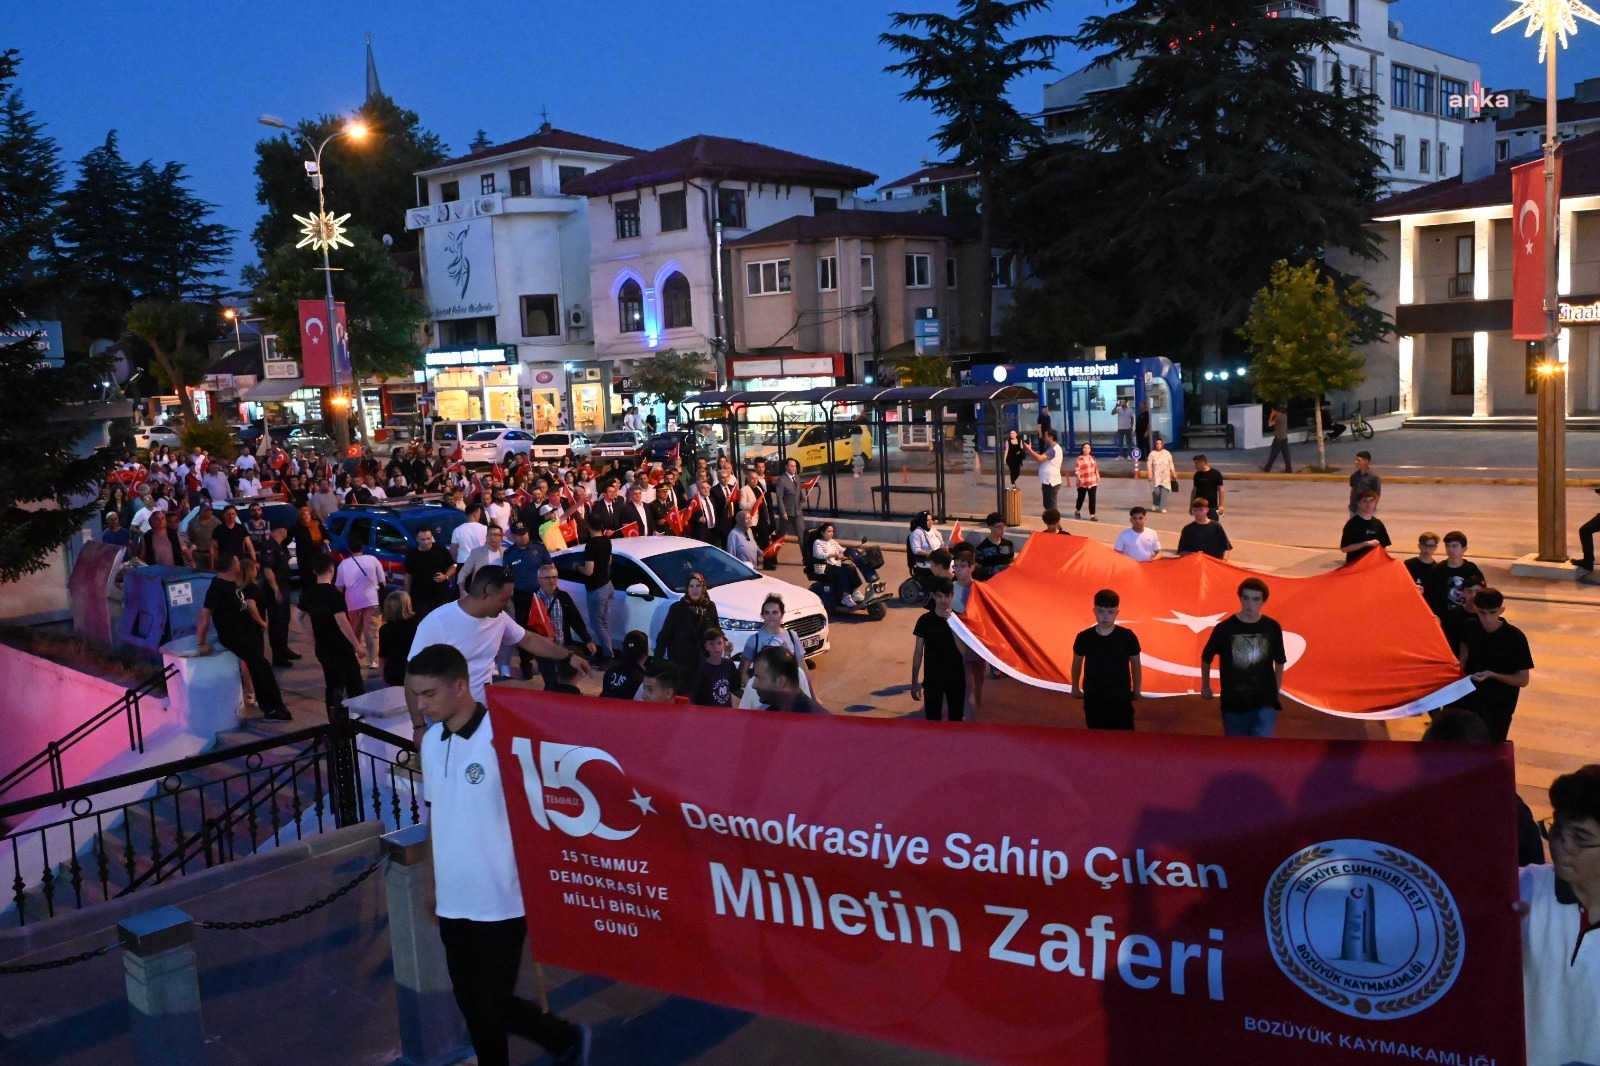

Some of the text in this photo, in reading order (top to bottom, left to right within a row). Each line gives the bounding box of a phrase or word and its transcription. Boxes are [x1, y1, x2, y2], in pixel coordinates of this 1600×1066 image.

[1027, 363, 1119, 378] BOZÜYÜK BELEDİYESİ
[561, 849, 650, 874] 15 TEMMUZ
[680, 802, 1228, 890] Demokrasiye Sahip Çıkan
[549, 869, 669, 900] DEMOKRASİ VE
[1296, 864, 1428, 912] TÜRKİYE CUMHURİYETİ
[563, 891, 663, 921] MİLLİ BİRLİK
[594, 918, 638, 938] GÜNÜ
[709, 861, 1225, 1001] Milletin Zaferi
[1296, 943, 1426, 992] BOZÜYÜK KAYMAKAMLIĞI
[1244, 1016, 1496, 1066] BOZÜYÜK KAYMAKAMLIĞI
